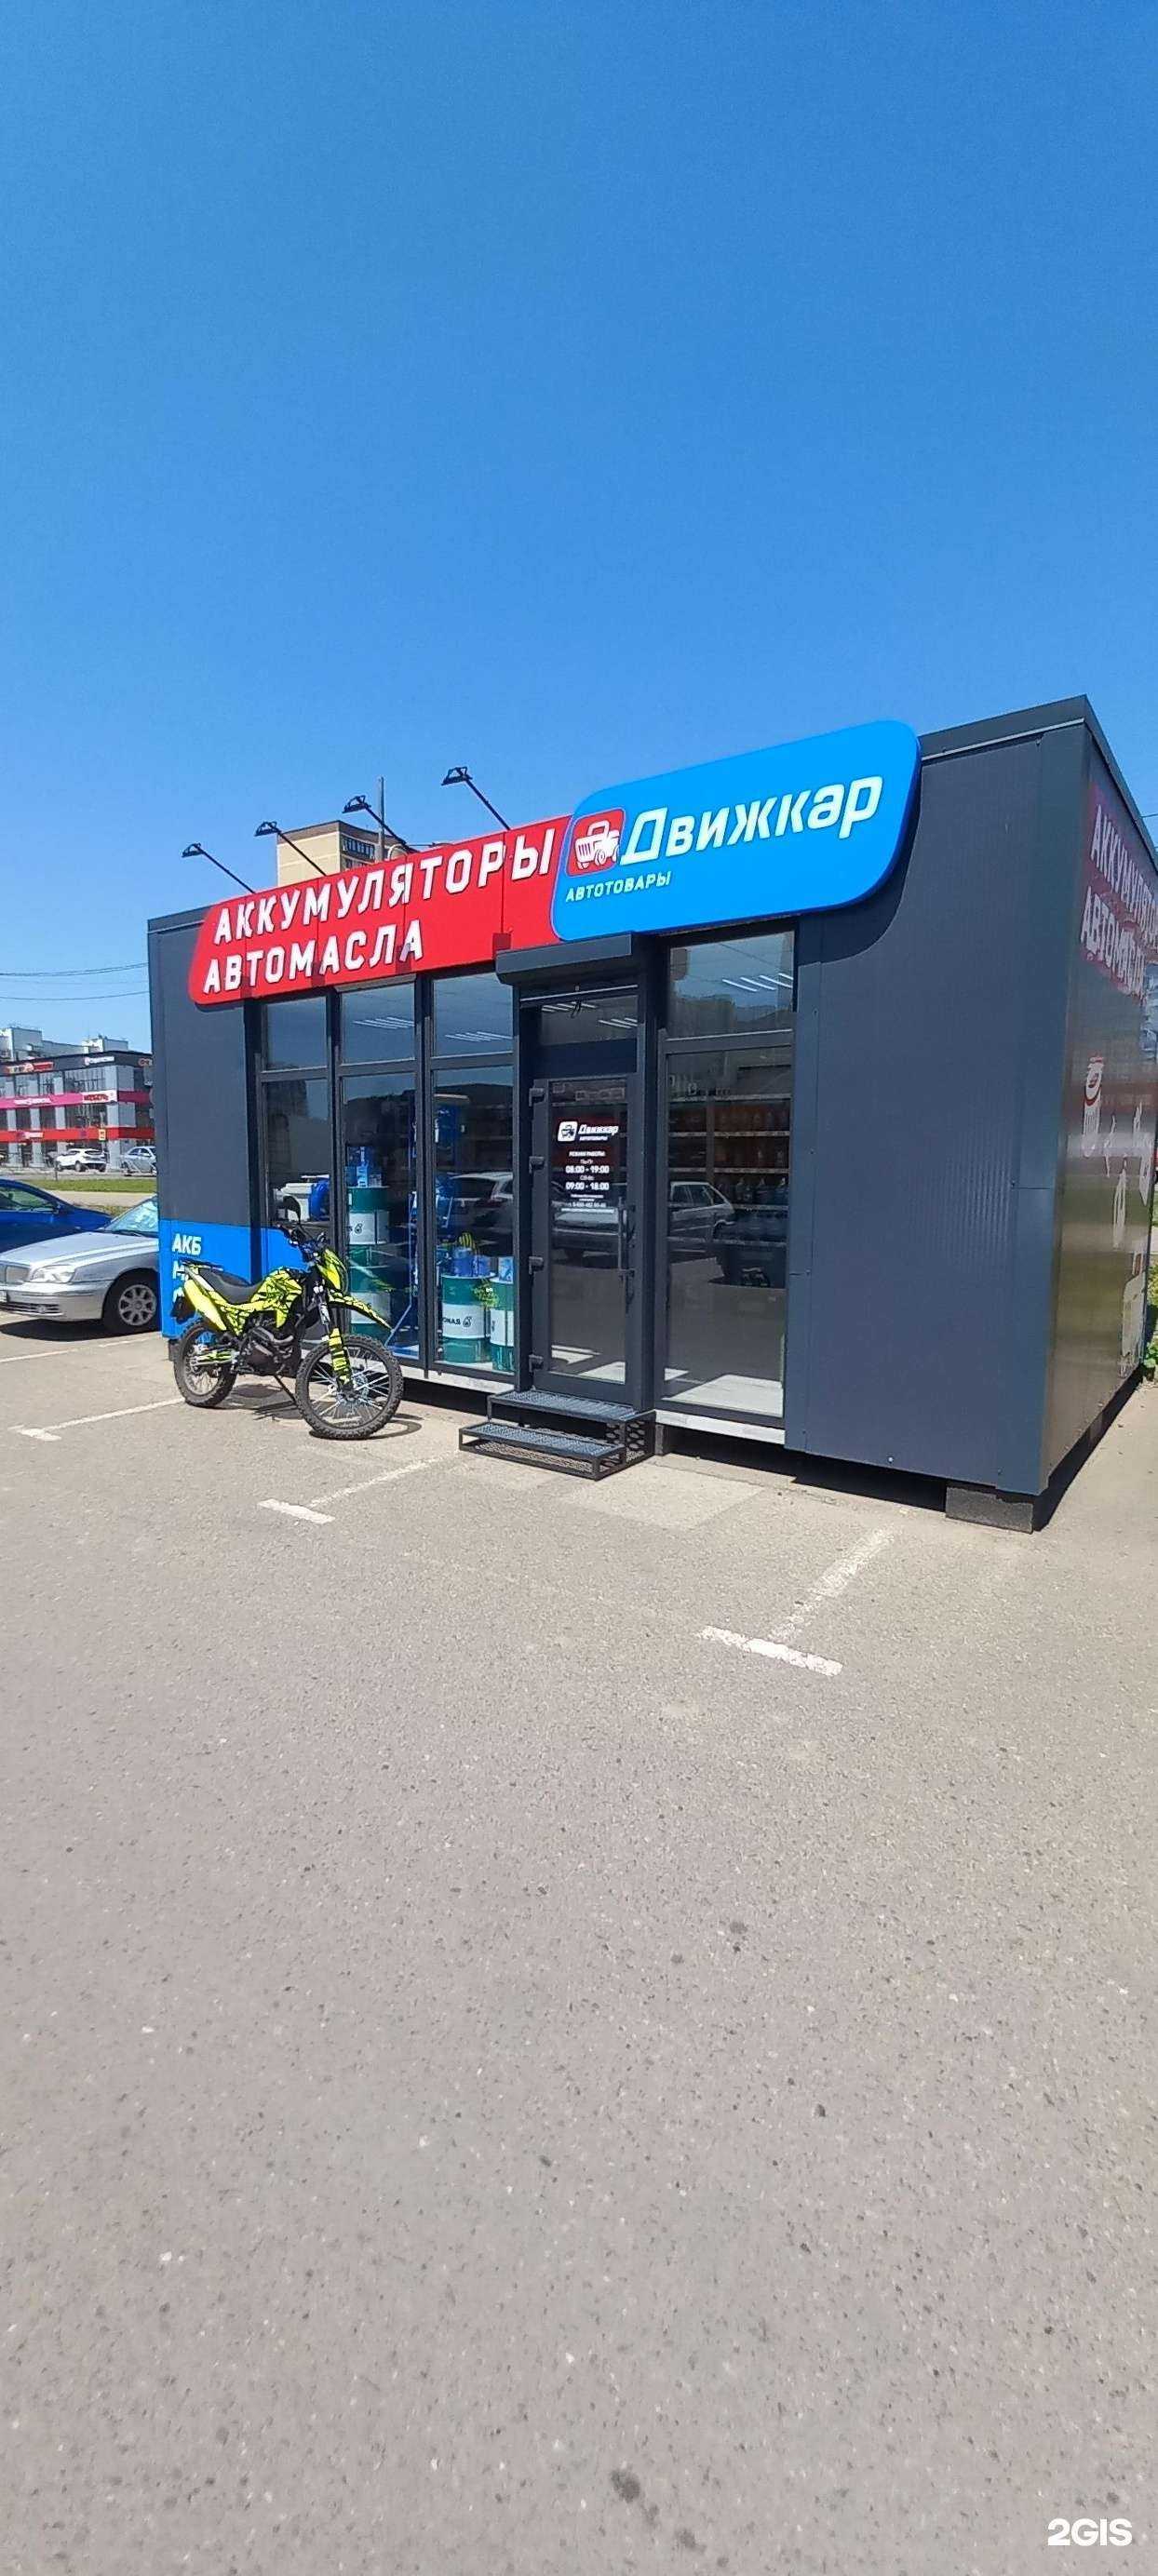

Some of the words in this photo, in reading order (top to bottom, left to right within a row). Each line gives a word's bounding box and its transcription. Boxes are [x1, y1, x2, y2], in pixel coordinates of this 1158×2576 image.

[618, 774, 883, 866] Движкар
[213, 827, 556, 946] АККУМУЛЯТОРЫ
[564, 870, 672, 903] АВТОТОВАРЫ
[202, 919, 424, 995] АВТОМАСЛА
[565, 1165, 585, 1174] 08:00
[589, 1165, 610, 1174] 19:00
[565, 1182, 585, 1190] 09:00
[589, 1182, 610, 1190] 18:00
[171, 1233, 202, 1256] АКБ
